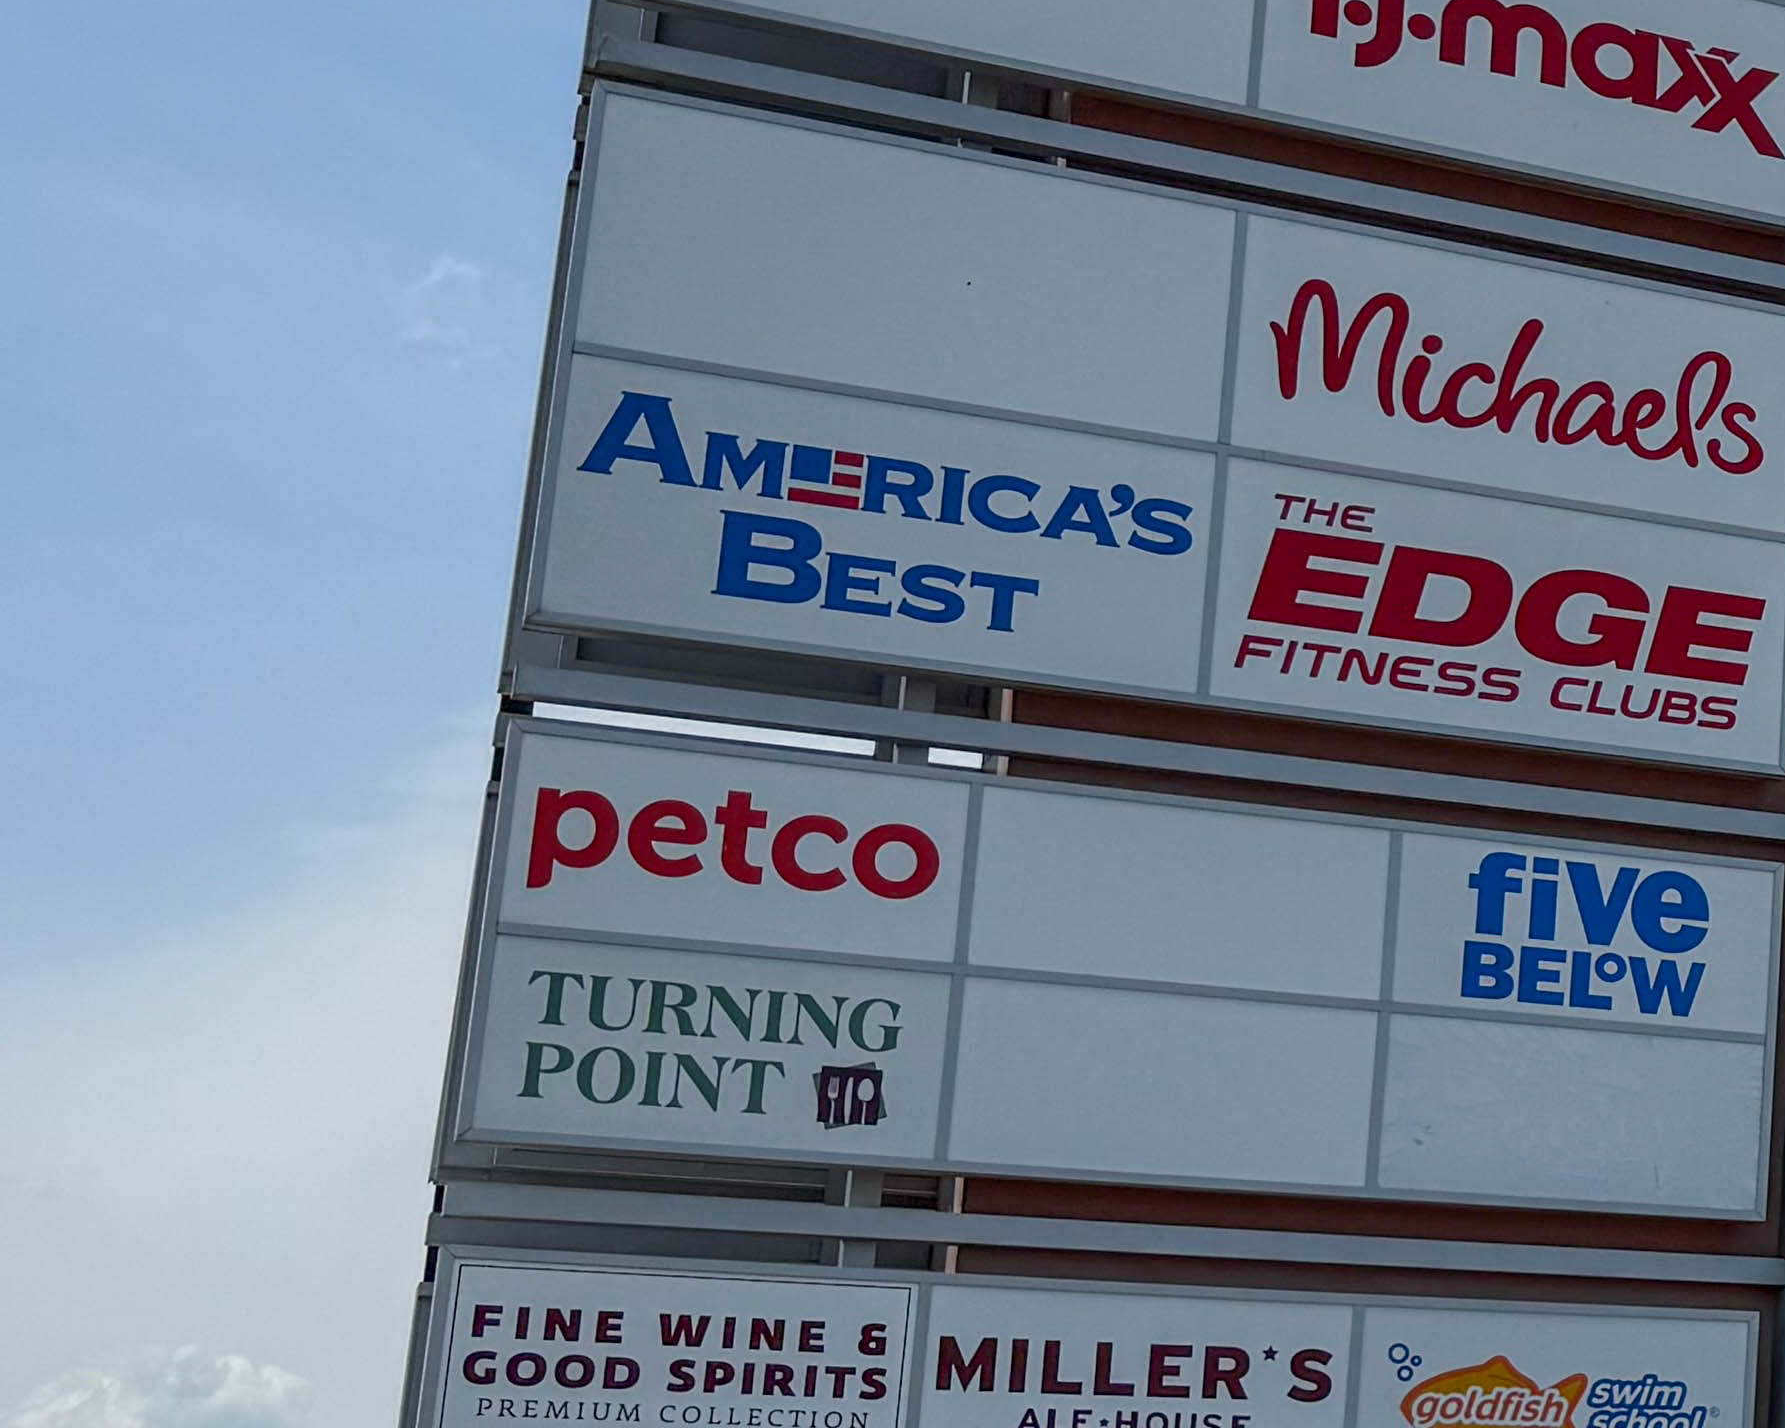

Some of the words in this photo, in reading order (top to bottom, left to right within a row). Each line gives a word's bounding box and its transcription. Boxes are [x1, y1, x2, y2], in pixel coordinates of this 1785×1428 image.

[1269, 278, 1764, 475] Michaels
[1274, 492, 1377, 534] THE
[710, 508, 1040, 634] BEST
[1245, 527, 1768, 687] EDGE
[1233, 634, 1521, 704] FITNESS
[1548, 677, 1739, 732] CLUBS
[524, 786, 941, 900] petco
[1468, 851, 1710, 954] five
[527, 969, 904, 1053] TURNING
[1460, 939, 1707, 1018] BELOW
[515, 1040, 787, 1115] POINT
[470, 1303, 626, 1344] FINE
[658, 1313, 826, 1354] WINE
[857, 1322, 888, 1356] &
[461, 1350, 642, 1391] GOOD
[665, 1358, 888, 1401] SPIRITS
[475, 1396, 642, 1423] PREMIUM
[1414, 1387, 1567, 1426] goldfish
[1589, 1375, 1684, 1408] swim
